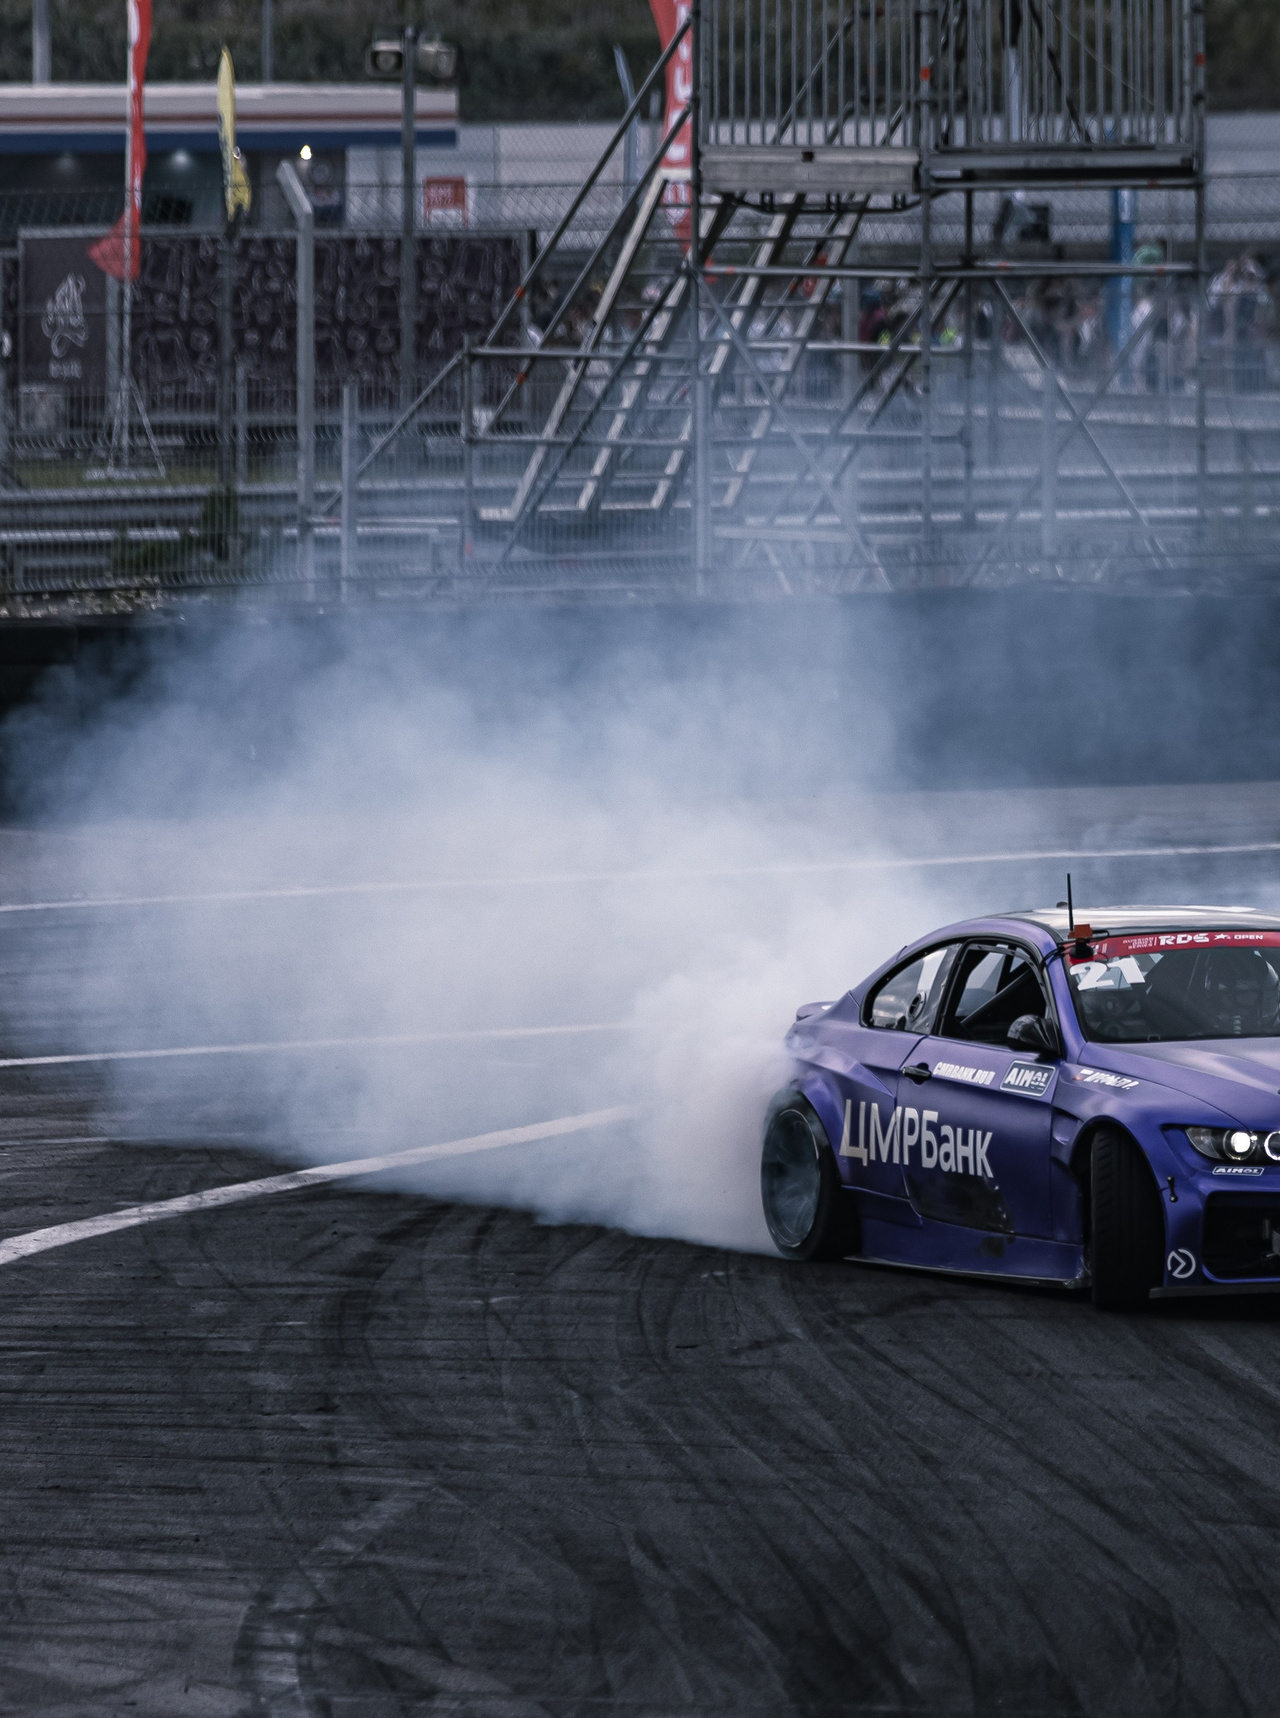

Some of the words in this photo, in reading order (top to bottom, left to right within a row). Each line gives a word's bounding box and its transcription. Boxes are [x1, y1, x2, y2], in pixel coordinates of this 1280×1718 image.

[1159, 933, 1210, 946] RDS
[1003, 1067, 1049, 1088] AIMOL
[838, 1098, 994, 1179] ЦМРБанк
